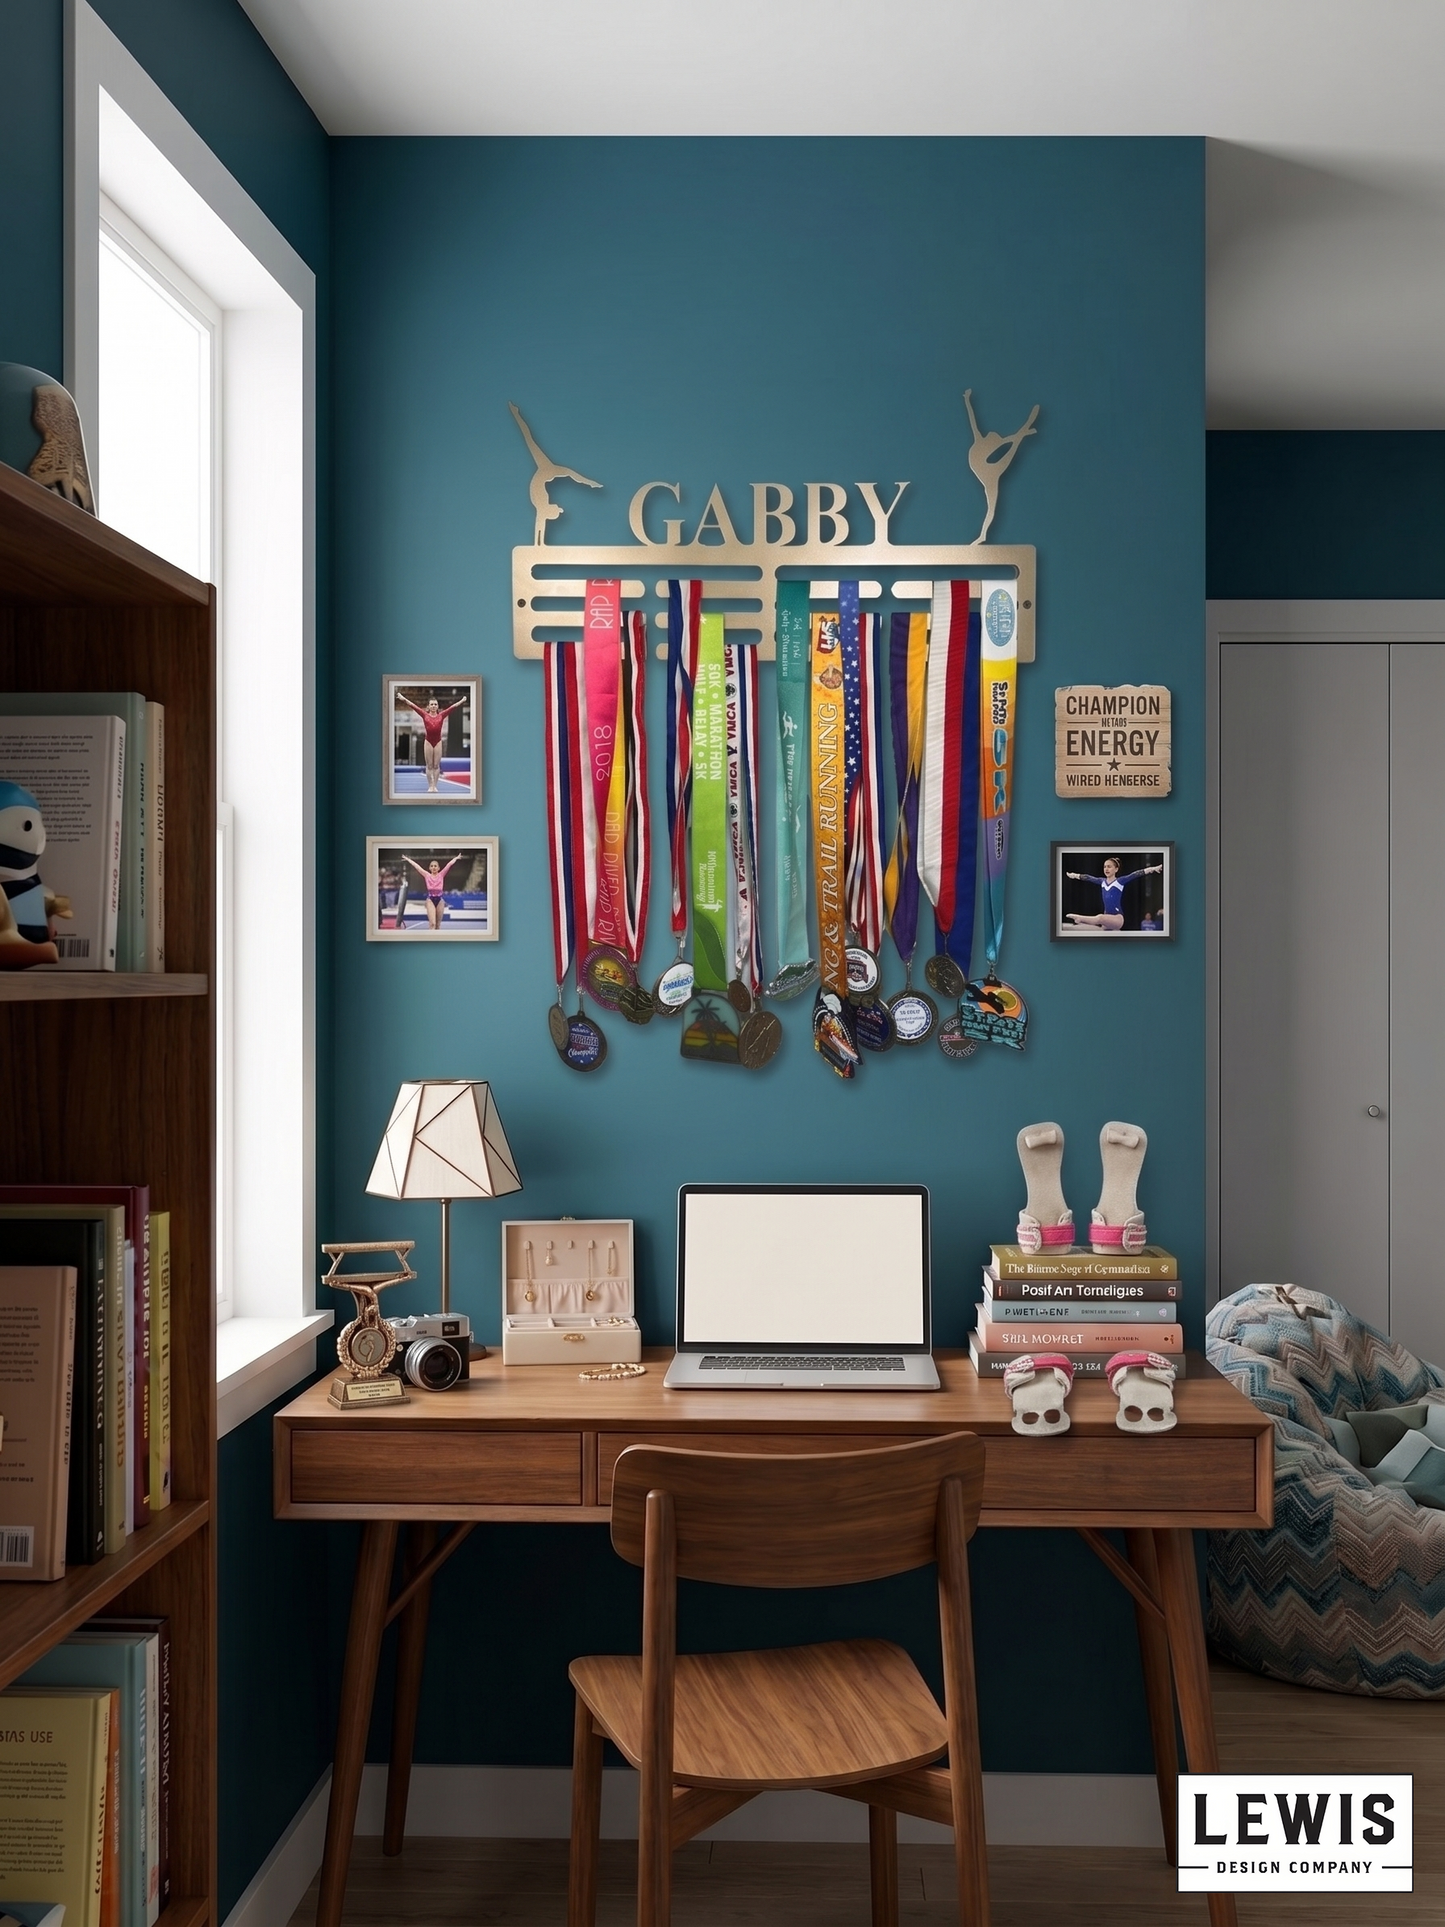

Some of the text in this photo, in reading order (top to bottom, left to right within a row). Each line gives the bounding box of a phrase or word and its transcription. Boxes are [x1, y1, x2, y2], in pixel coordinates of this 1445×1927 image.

[628, 481, 910, 547] GABBY
[726, 702, 737, 740] YMCA
[1066, 695, 1160, 715] CHAMPION
[593, 724, 613, 781] 2018
[709, 704, 723, 780] MARATHON
[1066, 730, 1160, 756] ENERGY
[817, 702, 839, 832] RUNNING
[1066, 774, 1101, 787] WIRED
[820, 837, 839, 913] TRAIL
[1005, 1263, 1025, 1274] The
[30, 1731, 53, 1743] USE
